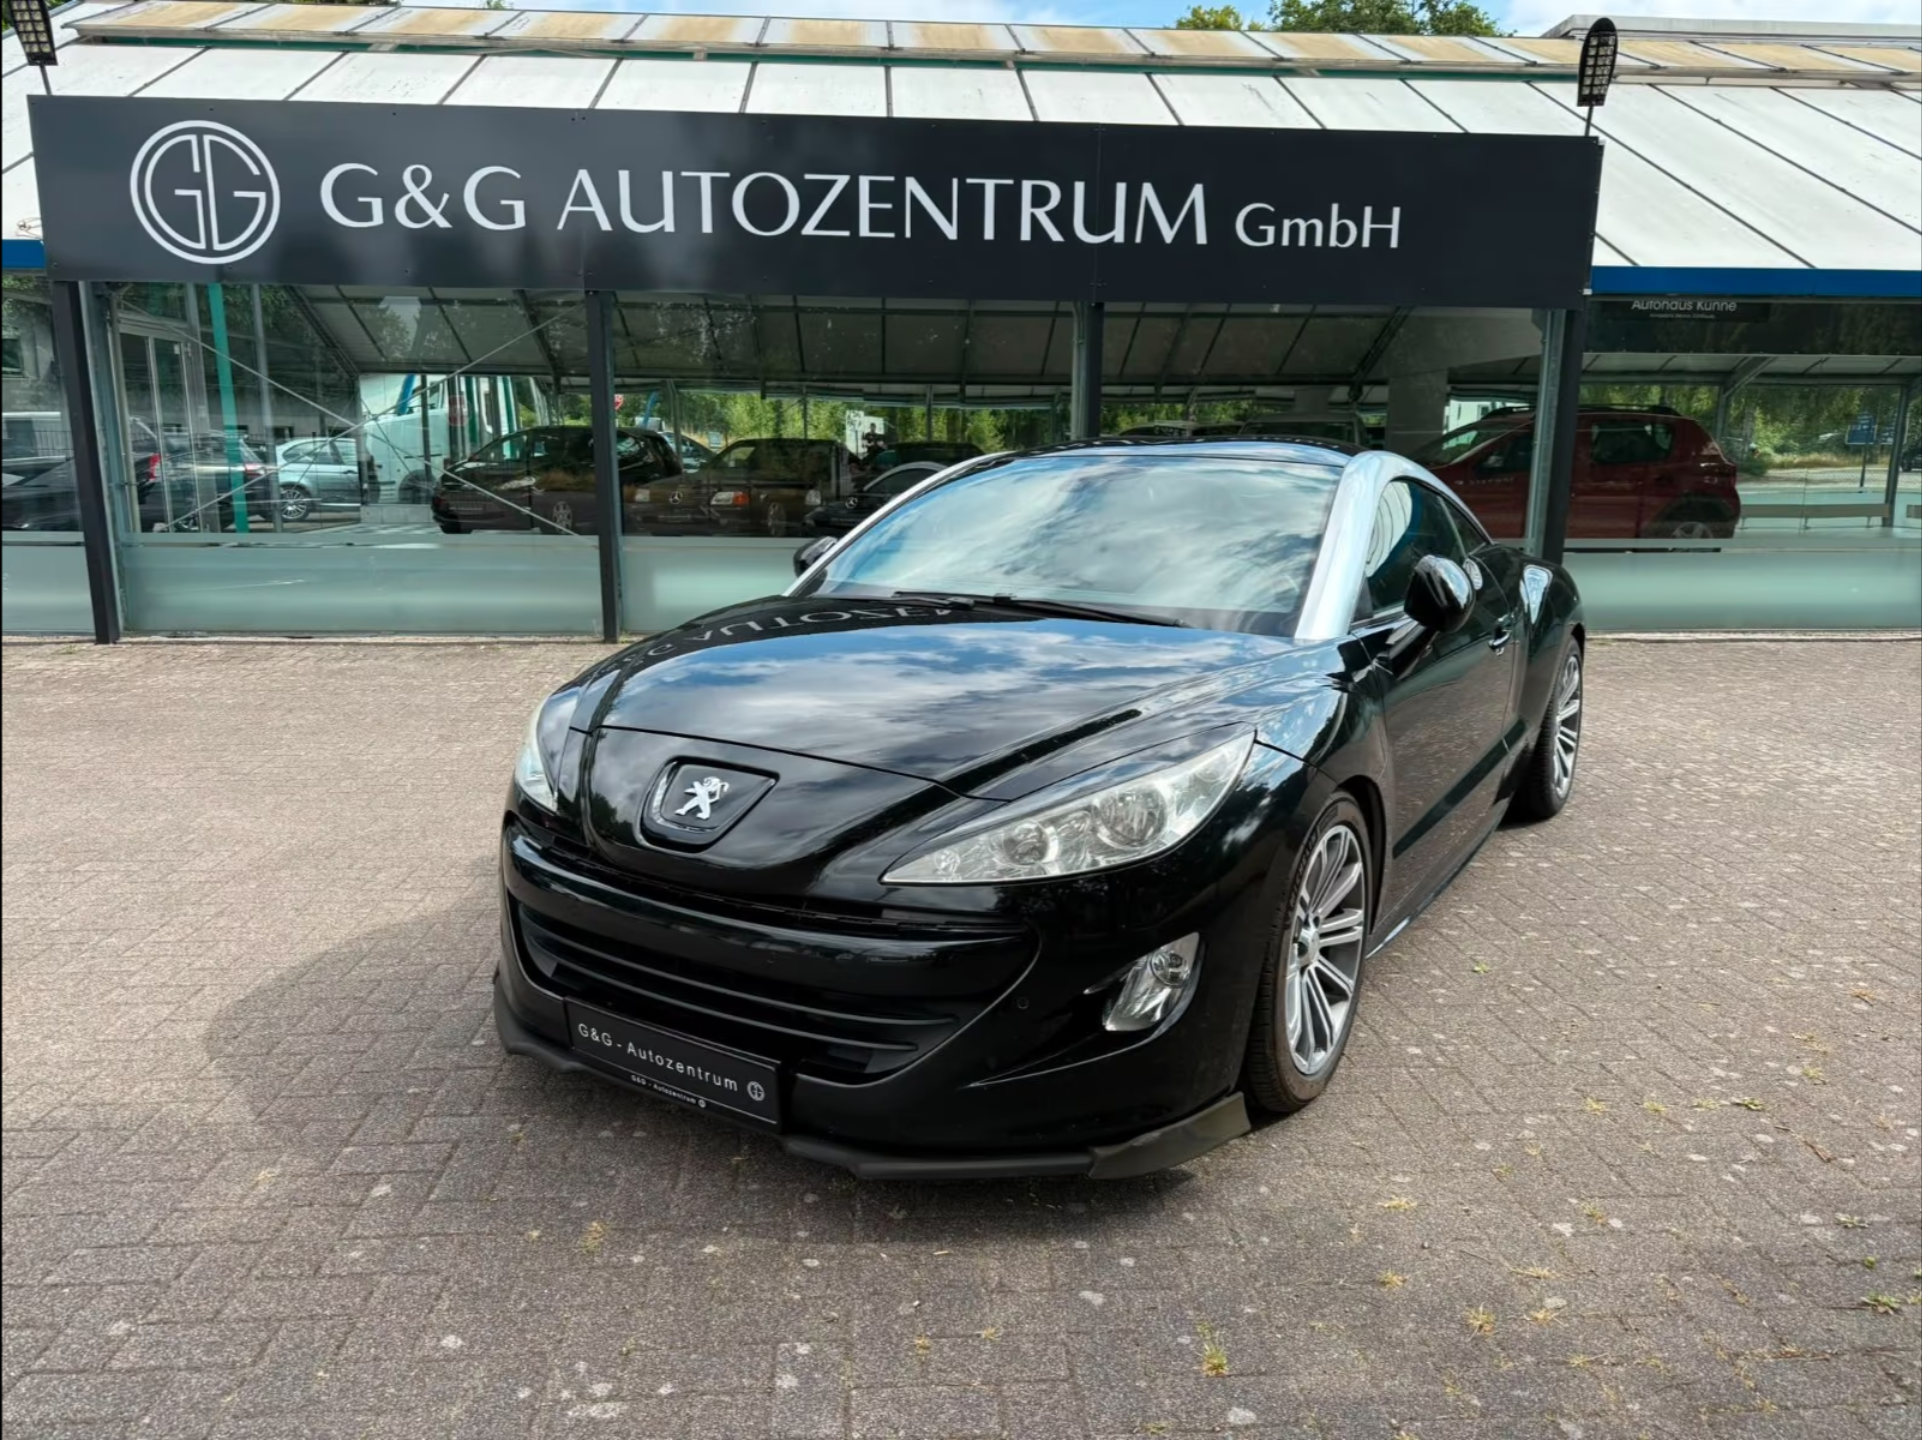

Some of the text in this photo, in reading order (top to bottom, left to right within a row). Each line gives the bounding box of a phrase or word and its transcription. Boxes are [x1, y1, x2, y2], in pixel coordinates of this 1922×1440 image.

[321, 163, 1400, 248] G&G AUTOZENTRUM GmbH
[578, 1022, 613, 1047] G&G
[627, 1041, 738, 1092] Autozentrum
